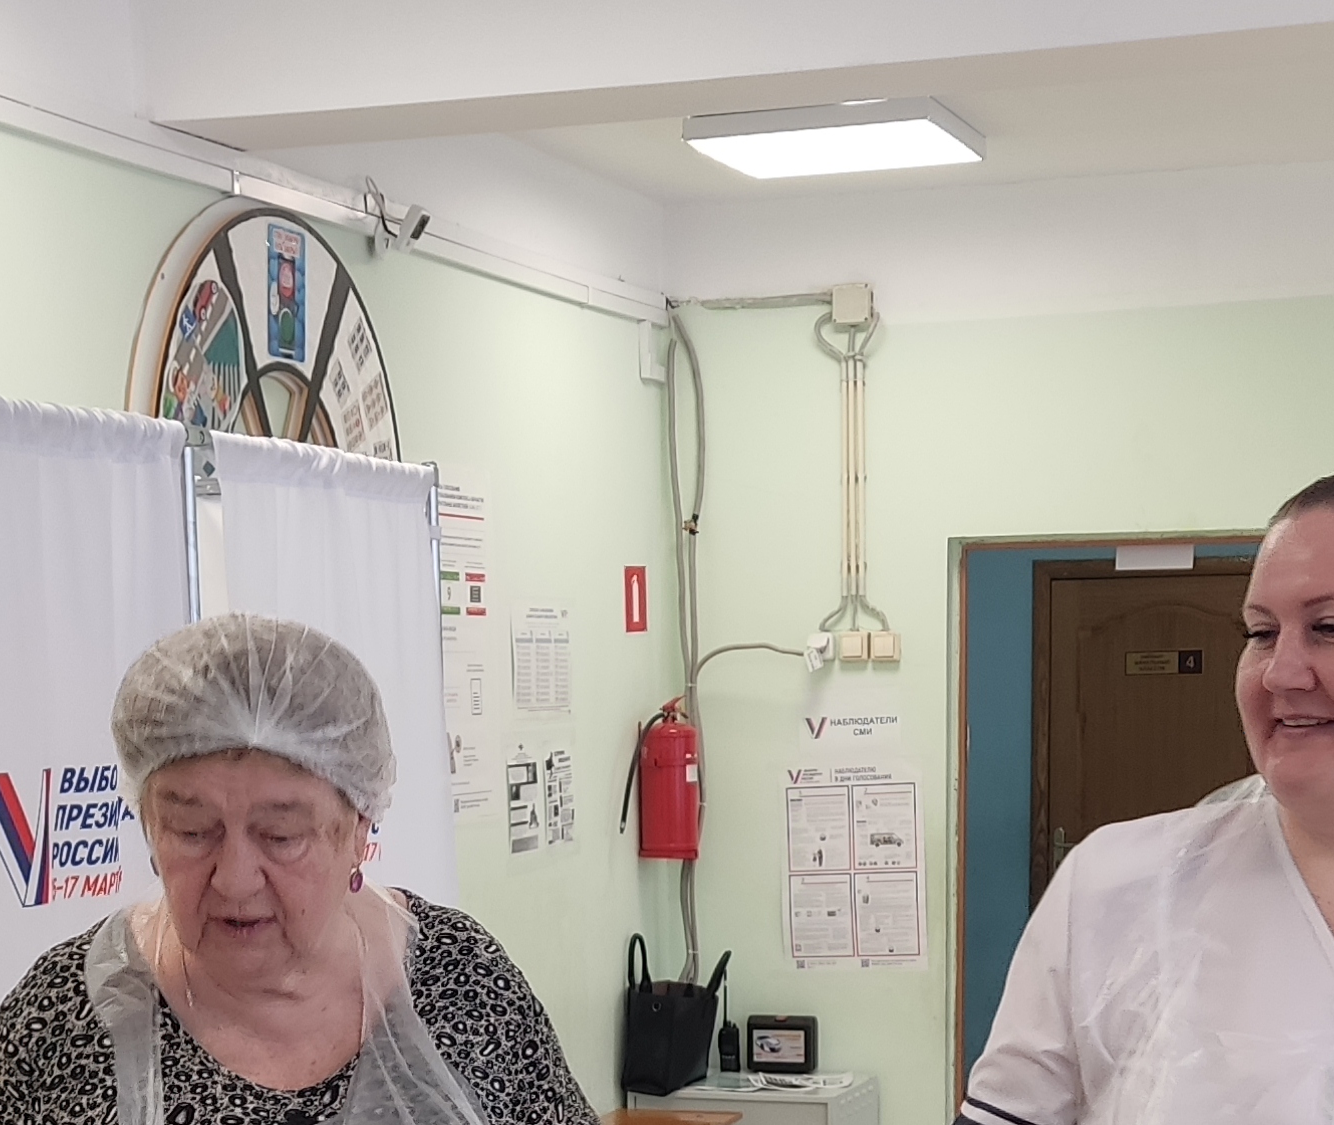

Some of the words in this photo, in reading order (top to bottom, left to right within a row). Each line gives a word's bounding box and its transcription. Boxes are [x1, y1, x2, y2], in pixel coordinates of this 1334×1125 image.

[1186, 655, 1195, 669] 4
[830, 716, 898, 727] НАБЛЮДАТЕЛИ
[853, 728, 873, 736] СМИ
[59, 764, 118, 794] ВЫБО
